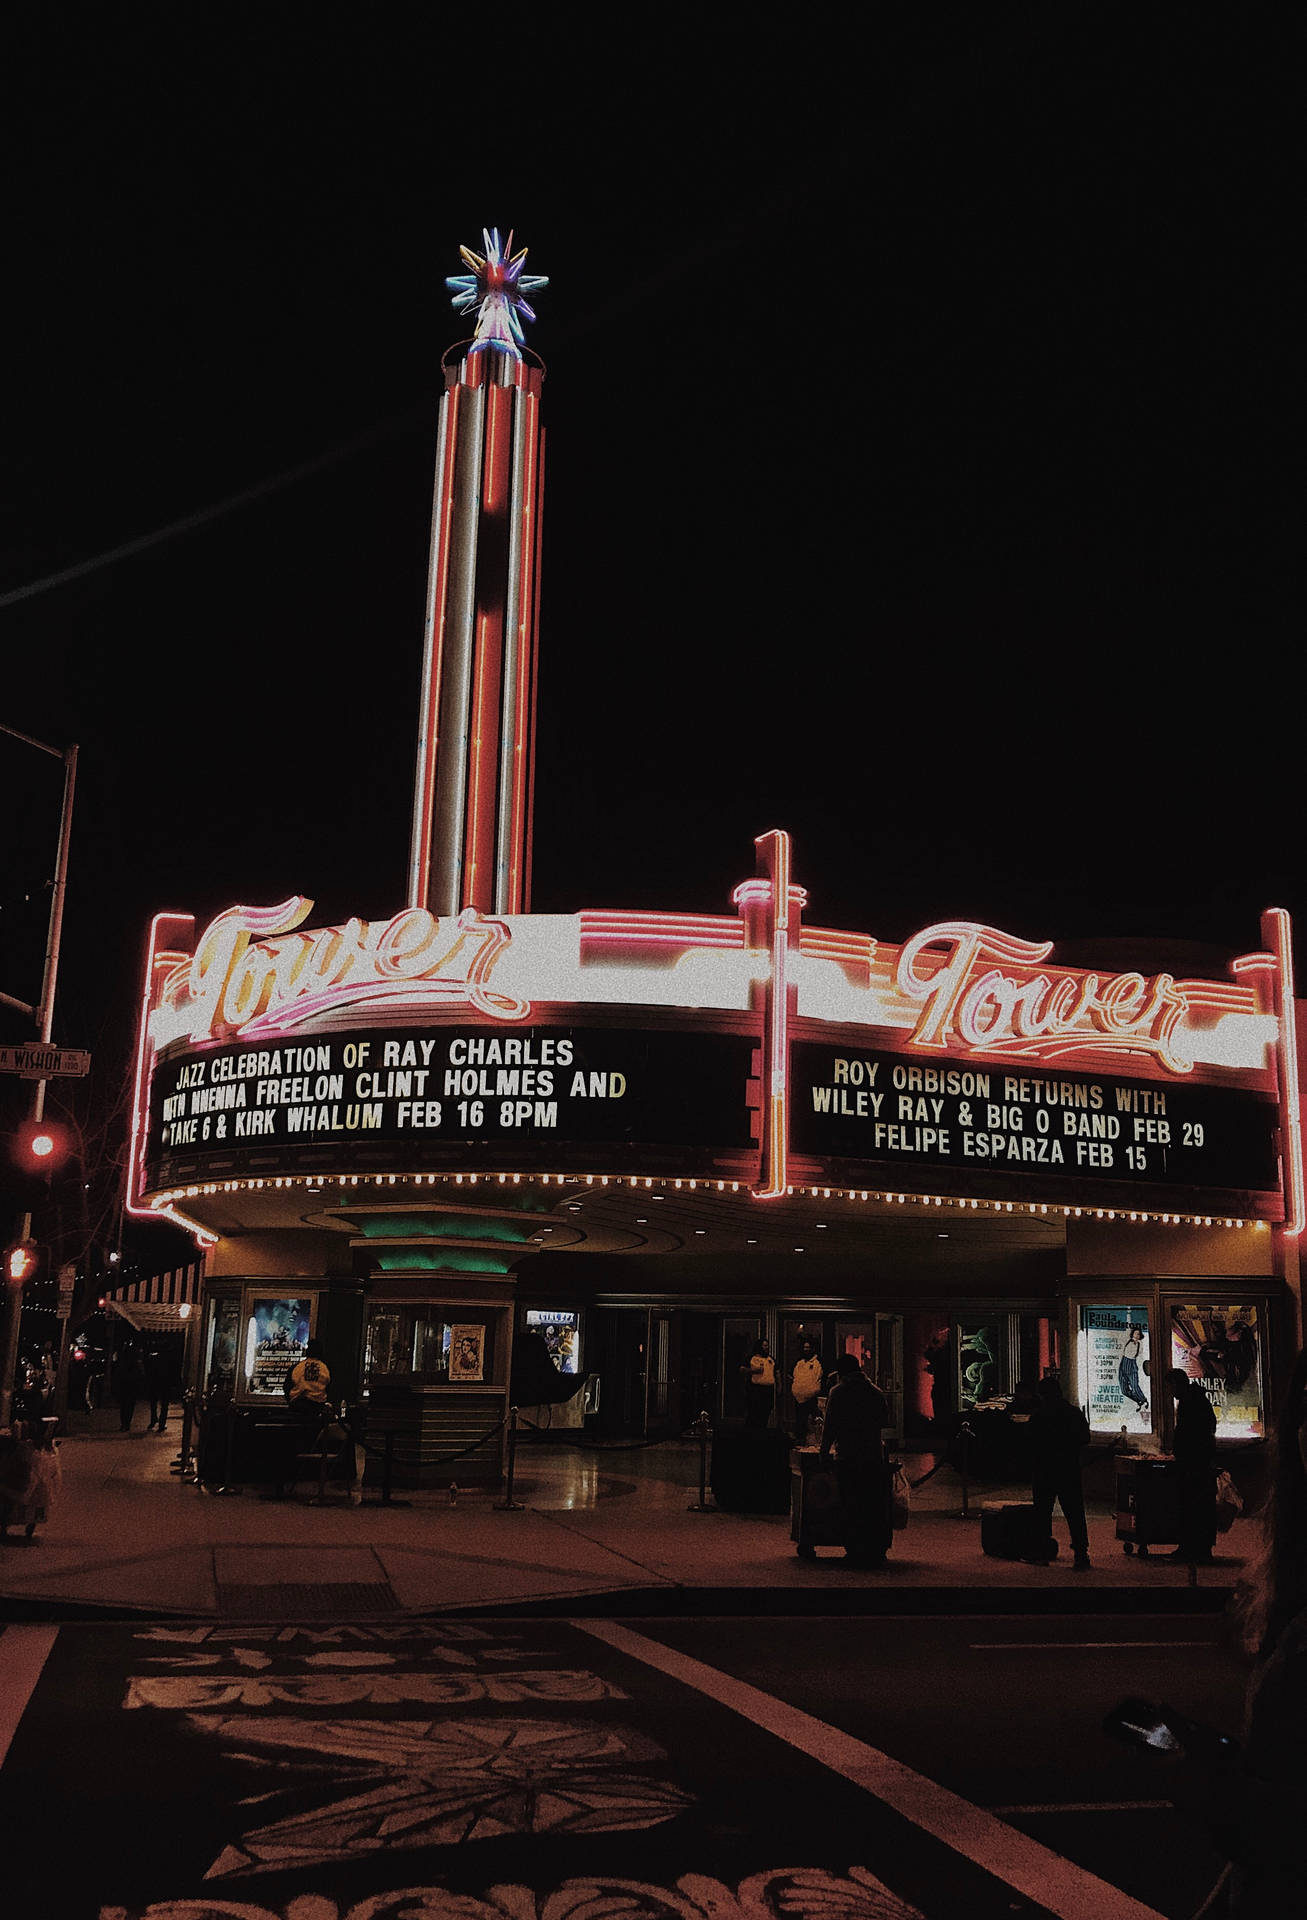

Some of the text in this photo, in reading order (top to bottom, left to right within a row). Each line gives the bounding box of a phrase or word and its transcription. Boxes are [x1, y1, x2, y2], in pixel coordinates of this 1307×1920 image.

[190, 896, 530, 1040] Tower
[897, 921, 1194, 1073] Tower
[176, 1039, 574, 1091] JAZZ CELEBRATION OF RAY CHARLES
[834, 1058, 1166, 1116] ROY ORBISON RETURNS WITH
[191, 1083, 246, 1115] NNENNA
[256, 1074, 343, 1105] FREELON
[355, 1070, 429, 1098] CLINT
[444, 1069, 554, 1097] HOLMES
[570, 1071, 626, 1098] AND
[812, 1086, 1204, 1147] WILEY RAY & BIG O BAND FEB 29
[169, 1101, 558, 1146] TAKE 6 & KIRK WHALUM FEB 16 8PM
[875, 1123, 1147, 1171] FELIPE ESPARZA FEB 15
[1089, 1311, 1117, 1321] Paula
[1089, 1319, 1148, 1330] Poundstone
